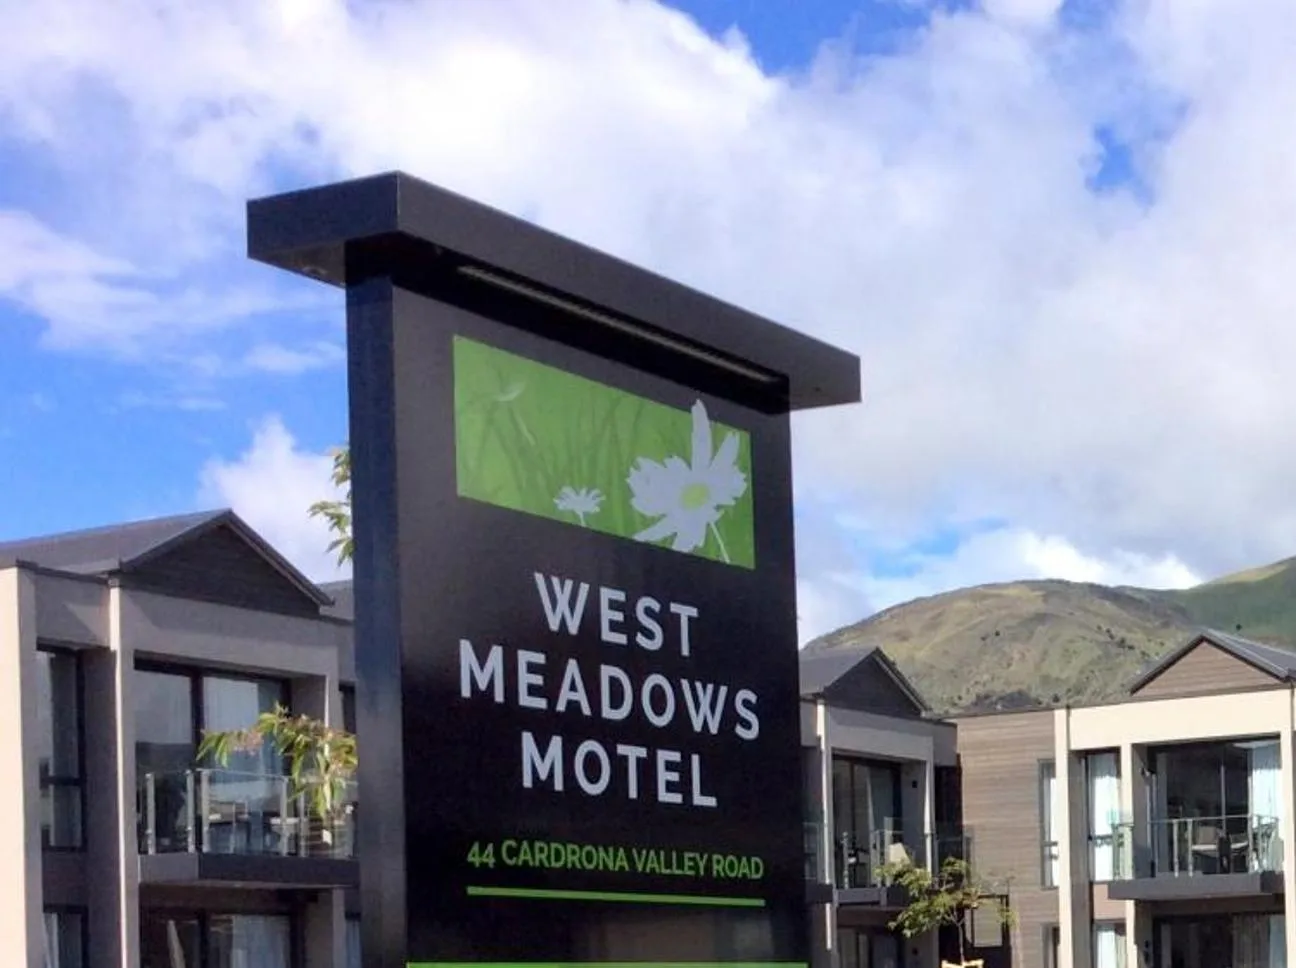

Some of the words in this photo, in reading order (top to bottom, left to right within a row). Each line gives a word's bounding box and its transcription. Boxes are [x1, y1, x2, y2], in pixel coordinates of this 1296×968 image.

[534, 572, 698, 657] WEST
[459, 638, 760, 740] MEADOWS
[521, 731, 718, 808] MOTEL
[467, 842, 495, 868] 44
[501, 839, 629, 871] CARDRONA
[632, 848, 708, 876] VALLEY
[712, 854, 764, 879] ROAD
